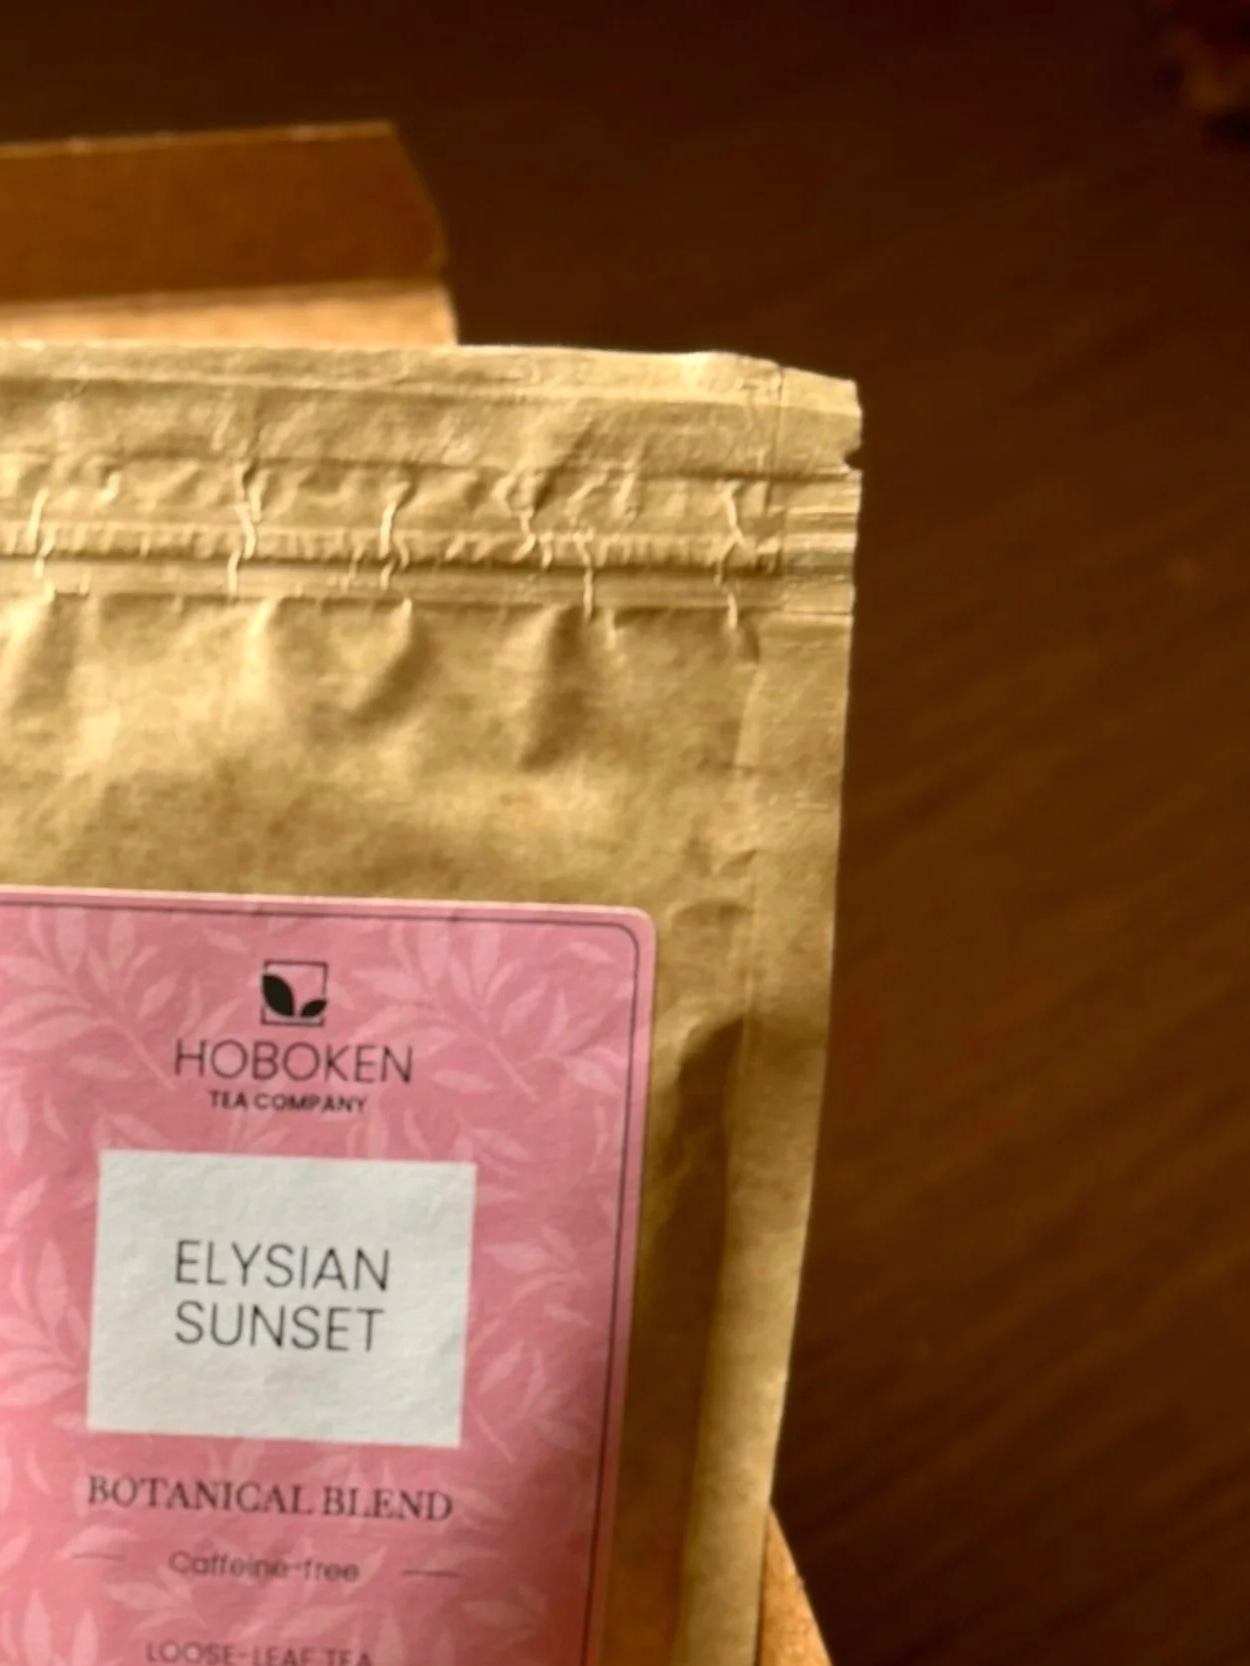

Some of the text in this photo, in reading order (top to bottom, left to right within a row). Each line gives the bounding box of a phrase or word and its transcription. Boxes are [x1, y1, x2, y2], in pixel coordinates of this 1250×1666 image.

[175, 1040, 413, 1085] HOBOKEN
[210, 1091, 367, 1114] TEA COMPANY
[176, 1240, 390, 1292] ELYSIAN
[175, 1301, 385, 1352] SUNSET
[87, 1476, 454, 1523] BOTANICAL BLEND
[168, 1551, 360, 1582] Caffeine-free
